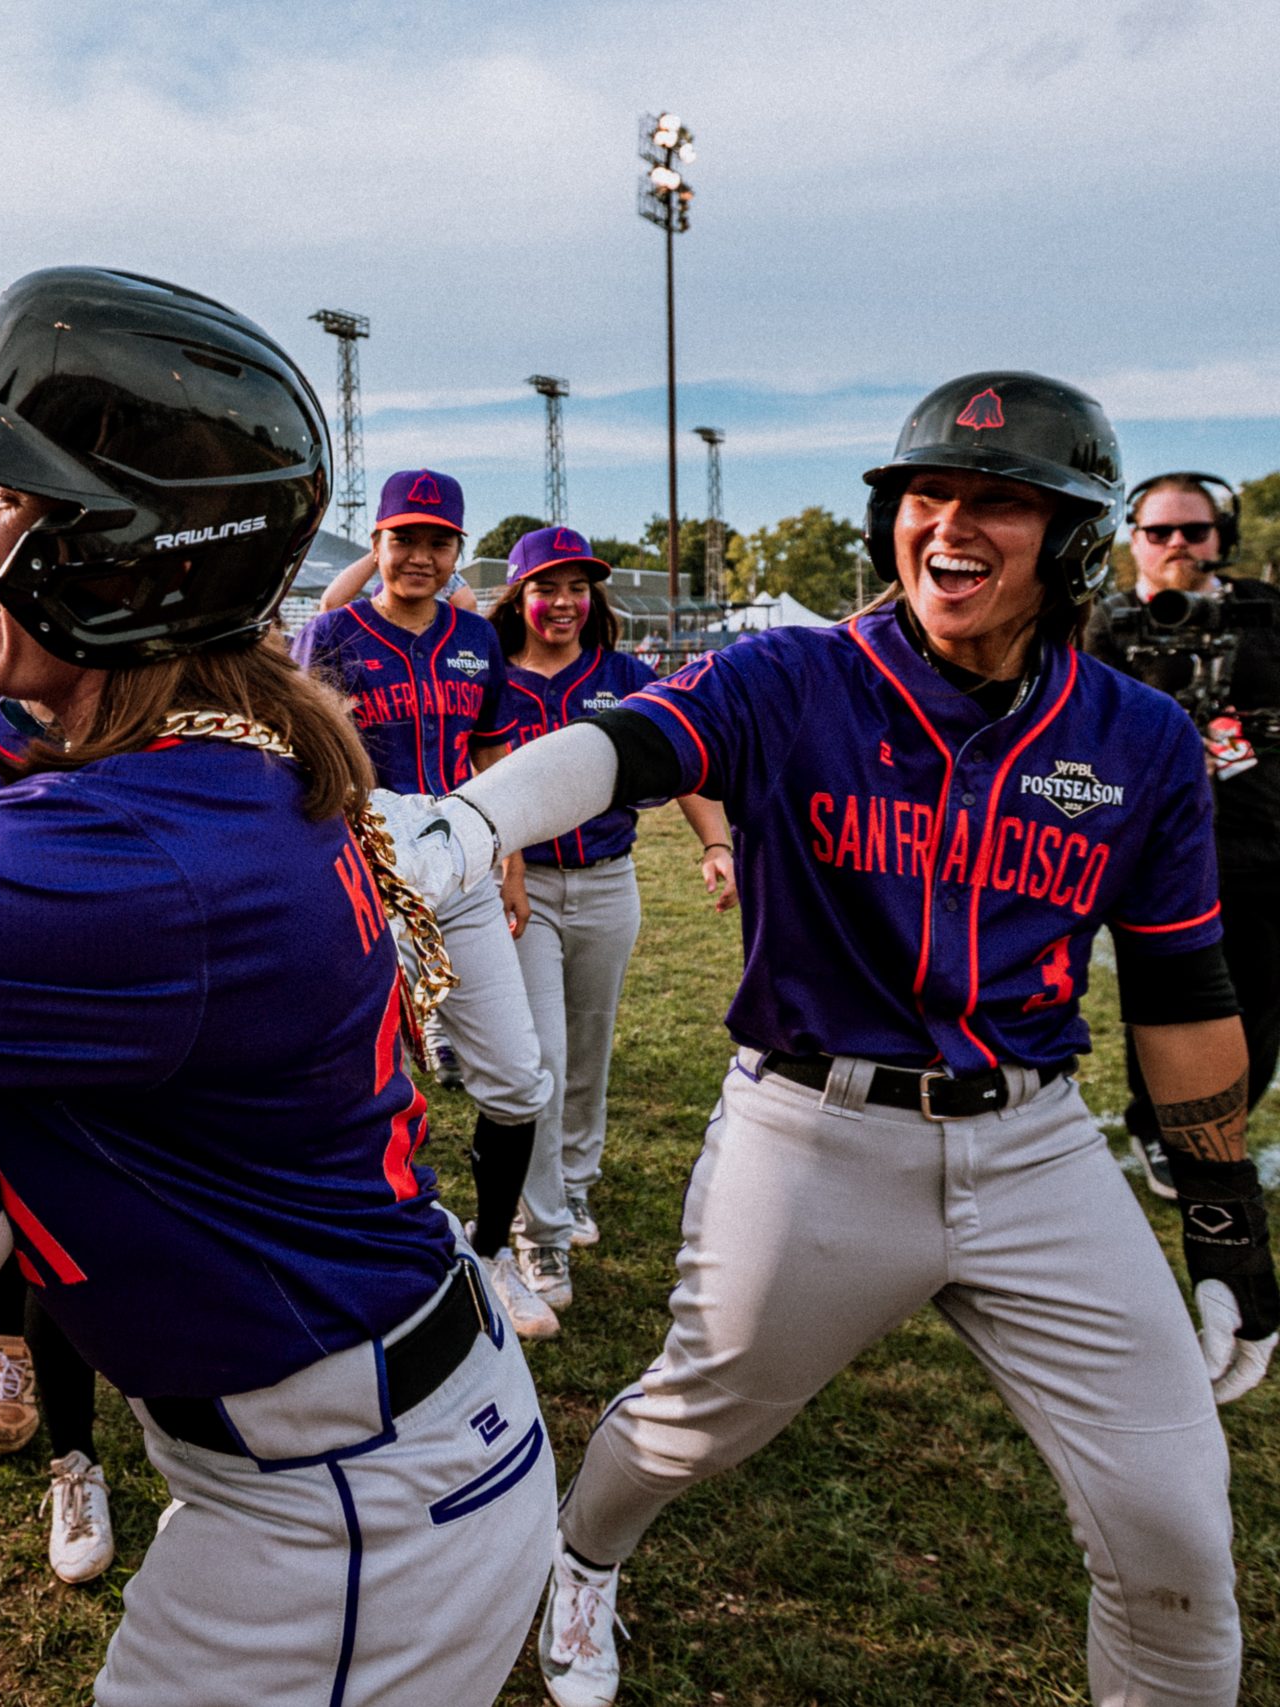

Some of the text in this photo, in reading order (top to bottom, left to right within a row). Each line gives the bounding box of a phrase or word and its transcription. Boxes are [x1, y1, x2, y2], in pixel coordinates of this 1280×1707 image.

[154, 515, 267, 550] RAWLINGS
[350, 679, 484, 730] SAN FRANCISCO
[1055, 760, 1096, 777] WPBL
[1020, 774, 1124, 806] POSTSEASON
[810, 791, 887, 874] SAN
